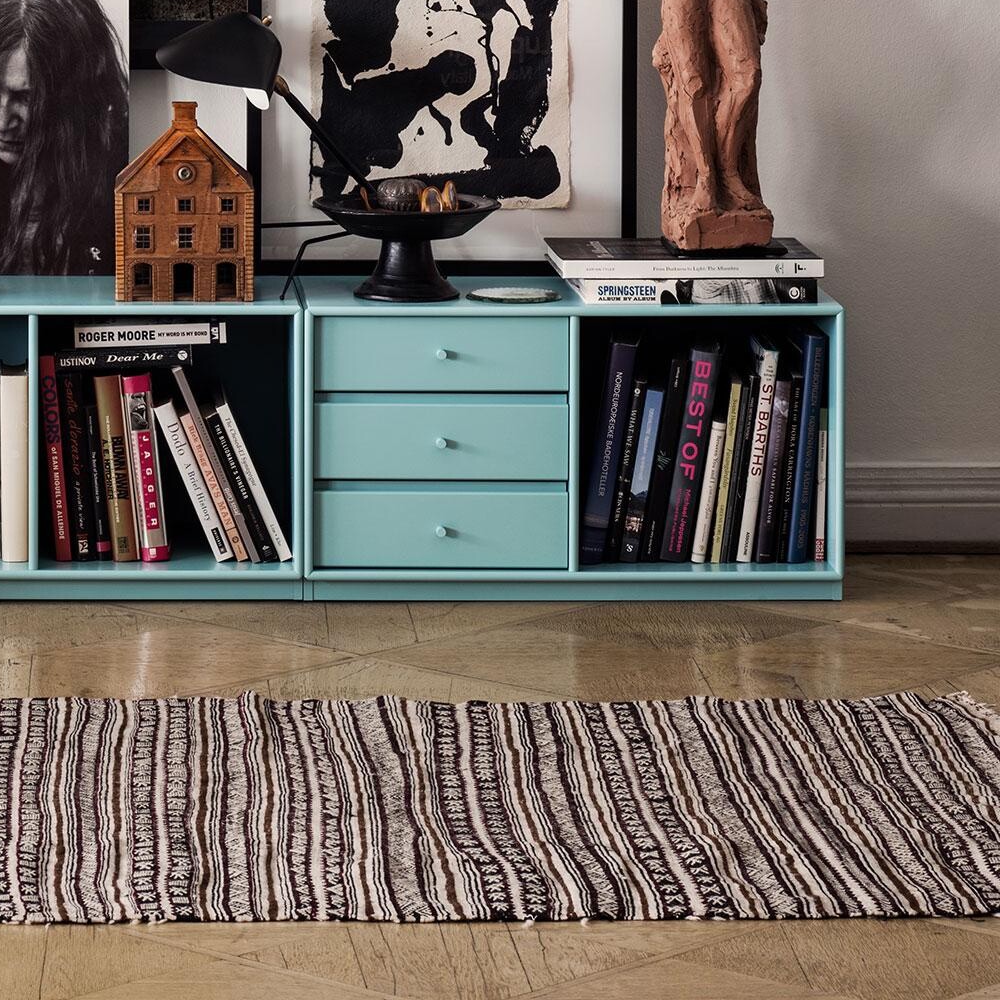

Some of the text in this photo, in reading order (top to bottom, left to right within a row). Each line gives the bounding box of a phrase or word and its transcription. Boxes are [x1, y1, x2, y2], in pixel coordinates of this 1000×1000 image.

[598, 285, 656, 296] SPRINGSTEEN
[60, 352, 164, 367] USTINOV Dear Me
[78, 331, 114, 343] ROGER
[117, 330, 156, 342] MOORE
[40, 375, 60, 443] COLORS
[680, 360, 712, 481] BEST OF
[751, 383, 773, 476] ST. BARTHS
[598, 371, 624, 497] NORDEUROPÆISKE BADEHOTELLER
[623, 409, 637, 466] WHAT WE SAW
[103, 458, 114, 500] HOTCHNER
[111, 435, 129, 500] BLOWN AWAY
[142, 436, 158, 526] JAGGER
[167, 422, 187, 456] Dodo
[187, 471, 200, 490] Brief
[196, 492, 211, 521] History
[188, 425, 199, 443] Rick
[195, 444, 206, 465] Bragg
[205, 470, 221, 498] AVA'S
[218, 502, 232, 526] MAN
[214, 424, 248, 499] THE BILLIONAIRE'S VINEGAR
[711, 458, 719, 469] You
[769, 467, 777, 489] SAFARI
[784, 424, 797, 503] DORA CARRINGTON
[55, 499, 61, 508] DE
[73, 486, 82, 511] private
[682, 489, 691, 518] Michael
[765, 504, 773, 523] ALVOR
[56, 510, 64, 539] ALLENDE
